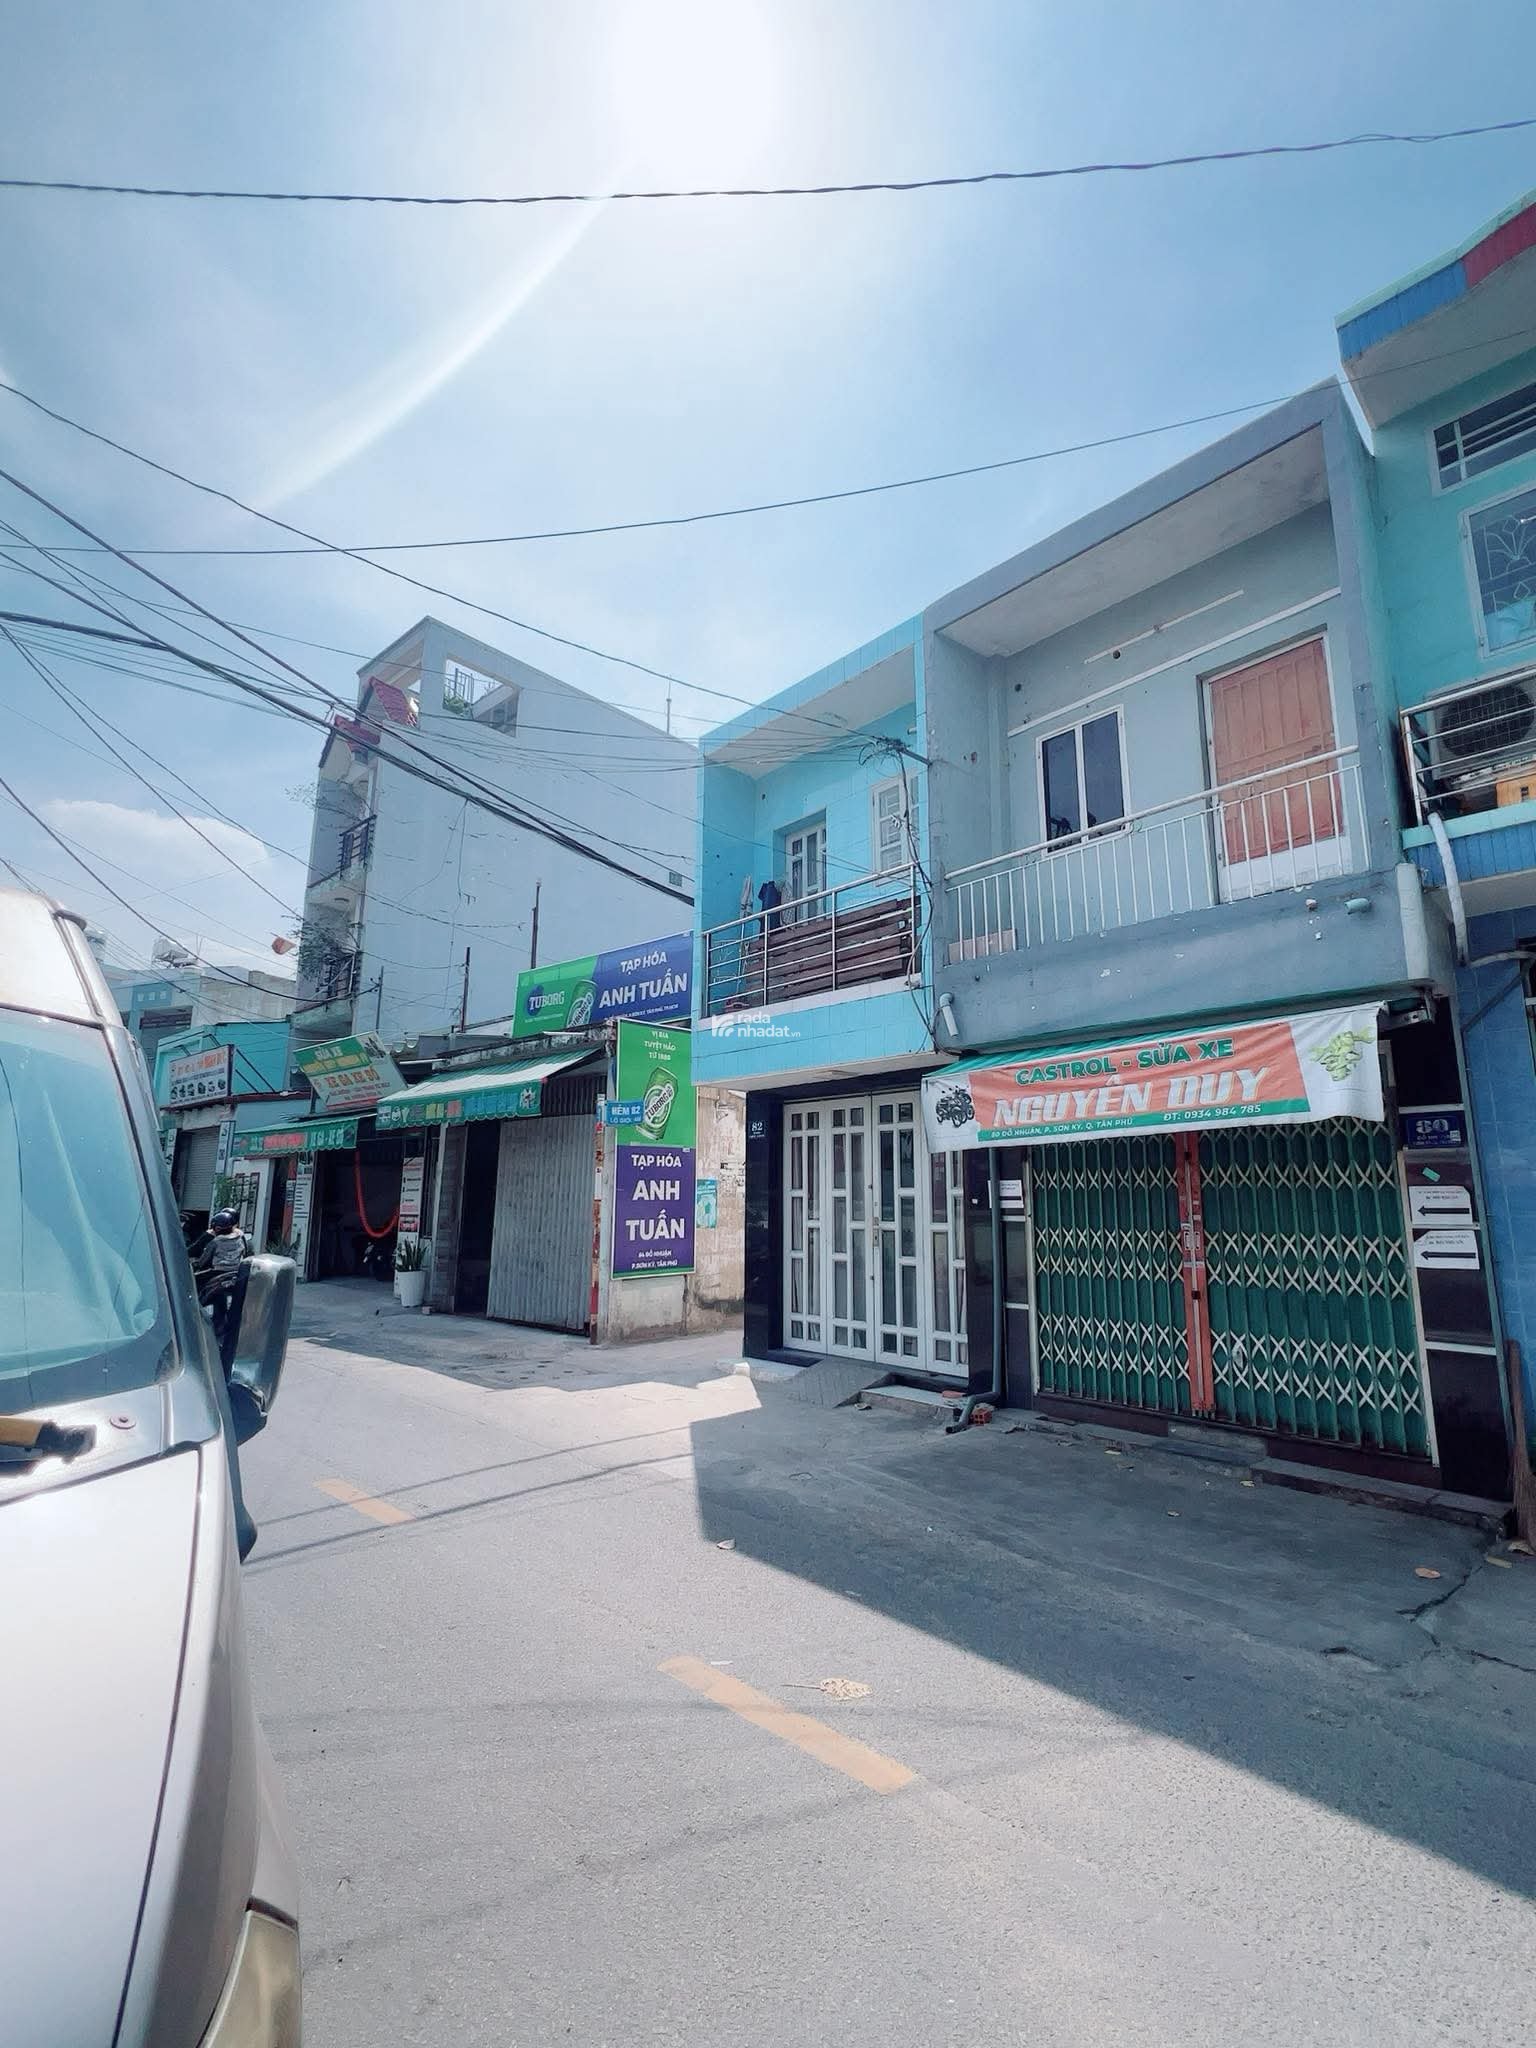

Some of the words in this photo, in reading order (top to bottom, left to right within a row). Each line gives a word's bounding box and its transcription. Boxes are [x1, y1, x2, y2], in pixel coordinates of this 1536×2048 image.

[621, 957, 641, 975] TẠP
[642, 951, 667, 968] HÓA
[599, 986, 636, 1009] ANH
[639, 968, 688, 1001] TUẤN
[529, 991, 565, 1010] TUBORG
[1015, 1056, 1117, 1086] CASTROL
[1136, 1040, 1191, 1068] SỬA
[1197, 1038, 1235, 1060] XE
[1167, 1066, 1271, 1110] DUY
[1184, 1109, 1212, 1119] 0934
[1215, 1107, 1237, 1116] 984
[1240, 1104, 1261, 1114] 785
[752, 1122, 763, 1132] 82
[1416, 1119, 1449, 1133] 80
[631, 1154, 655, 1170] TẠP
[656, 1153, 682, 1167] HÓA
[632, 1180, 680, 1200] ANH
[625, 1209, 685, 1241] TUẤN
